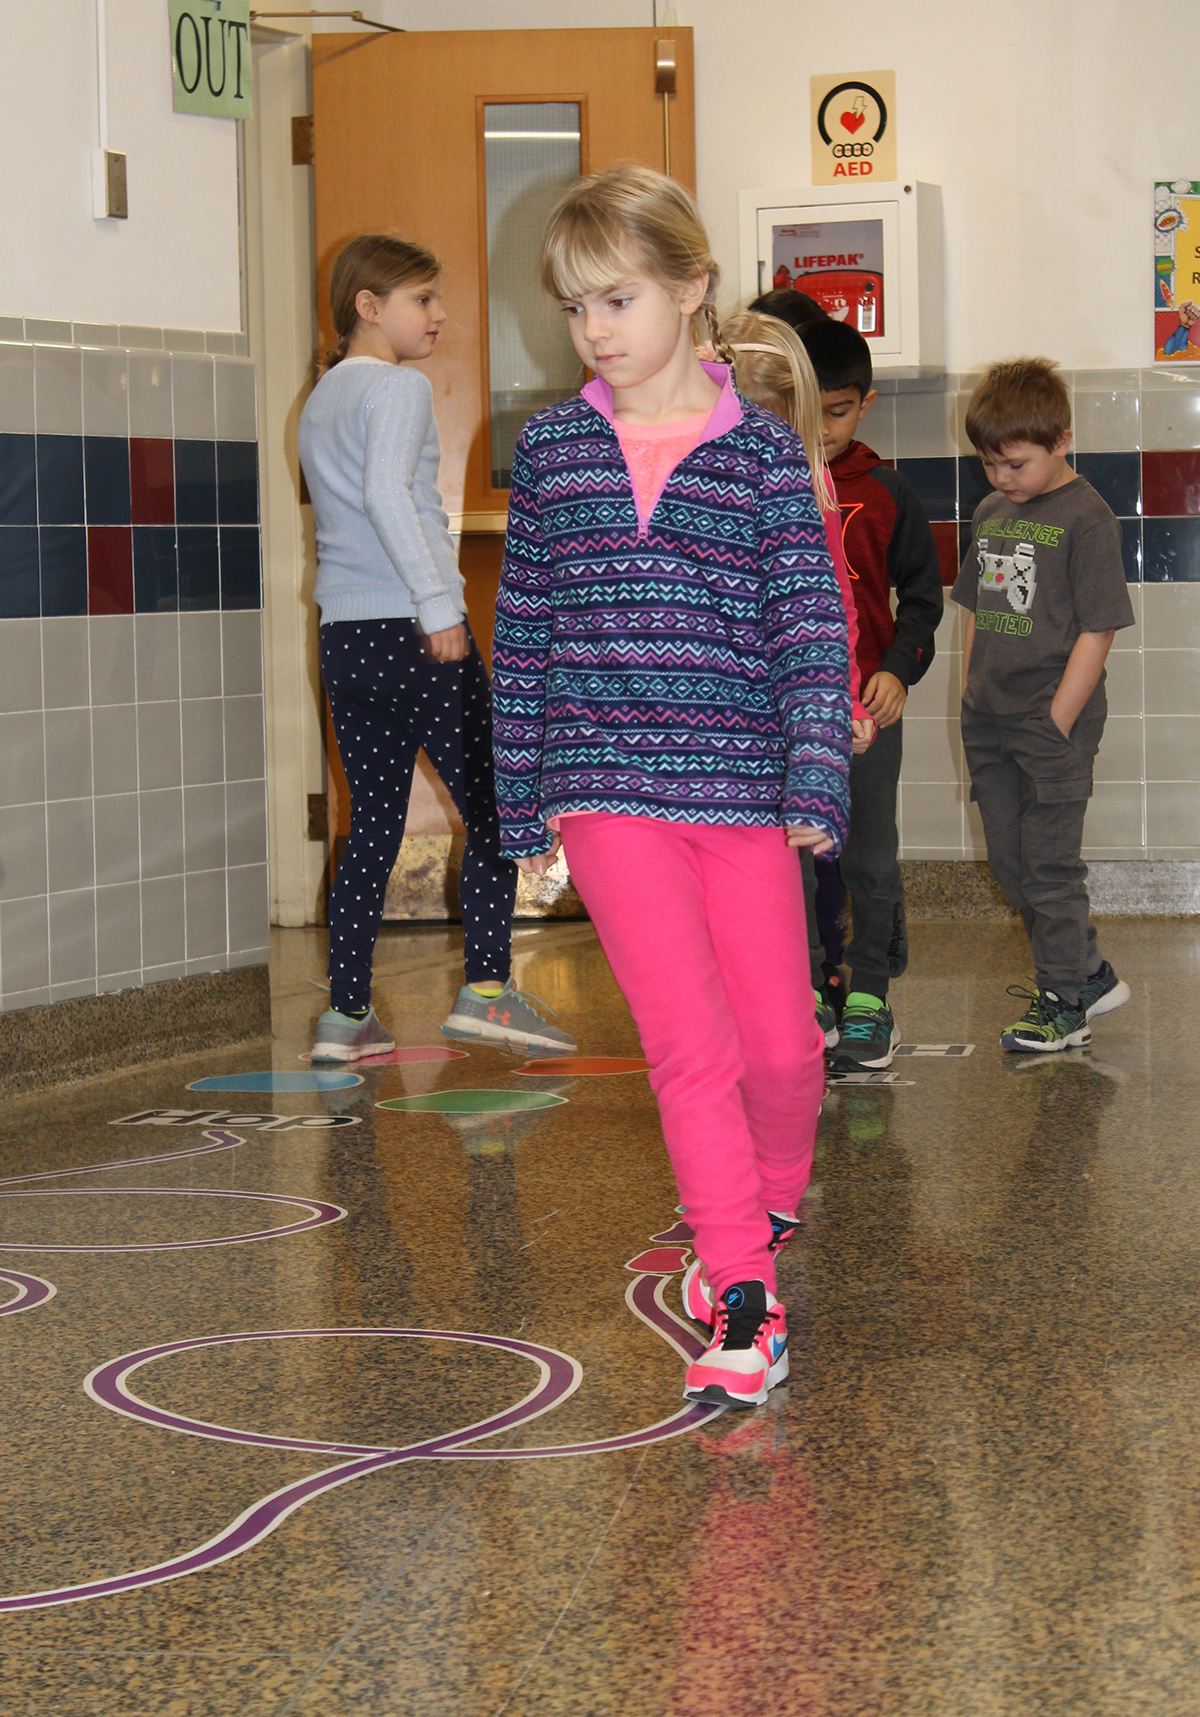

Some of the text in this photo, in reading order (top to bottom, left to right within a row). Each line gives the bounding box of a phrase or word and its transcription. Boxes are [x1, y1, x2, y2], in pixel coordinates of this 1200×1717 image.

[175, 12, 249, 99] OUT
[833, 161, 873, 177] AED
[976, 609, 1033, 636] EPTED
[107, 1109, 363, 1132] Hop
